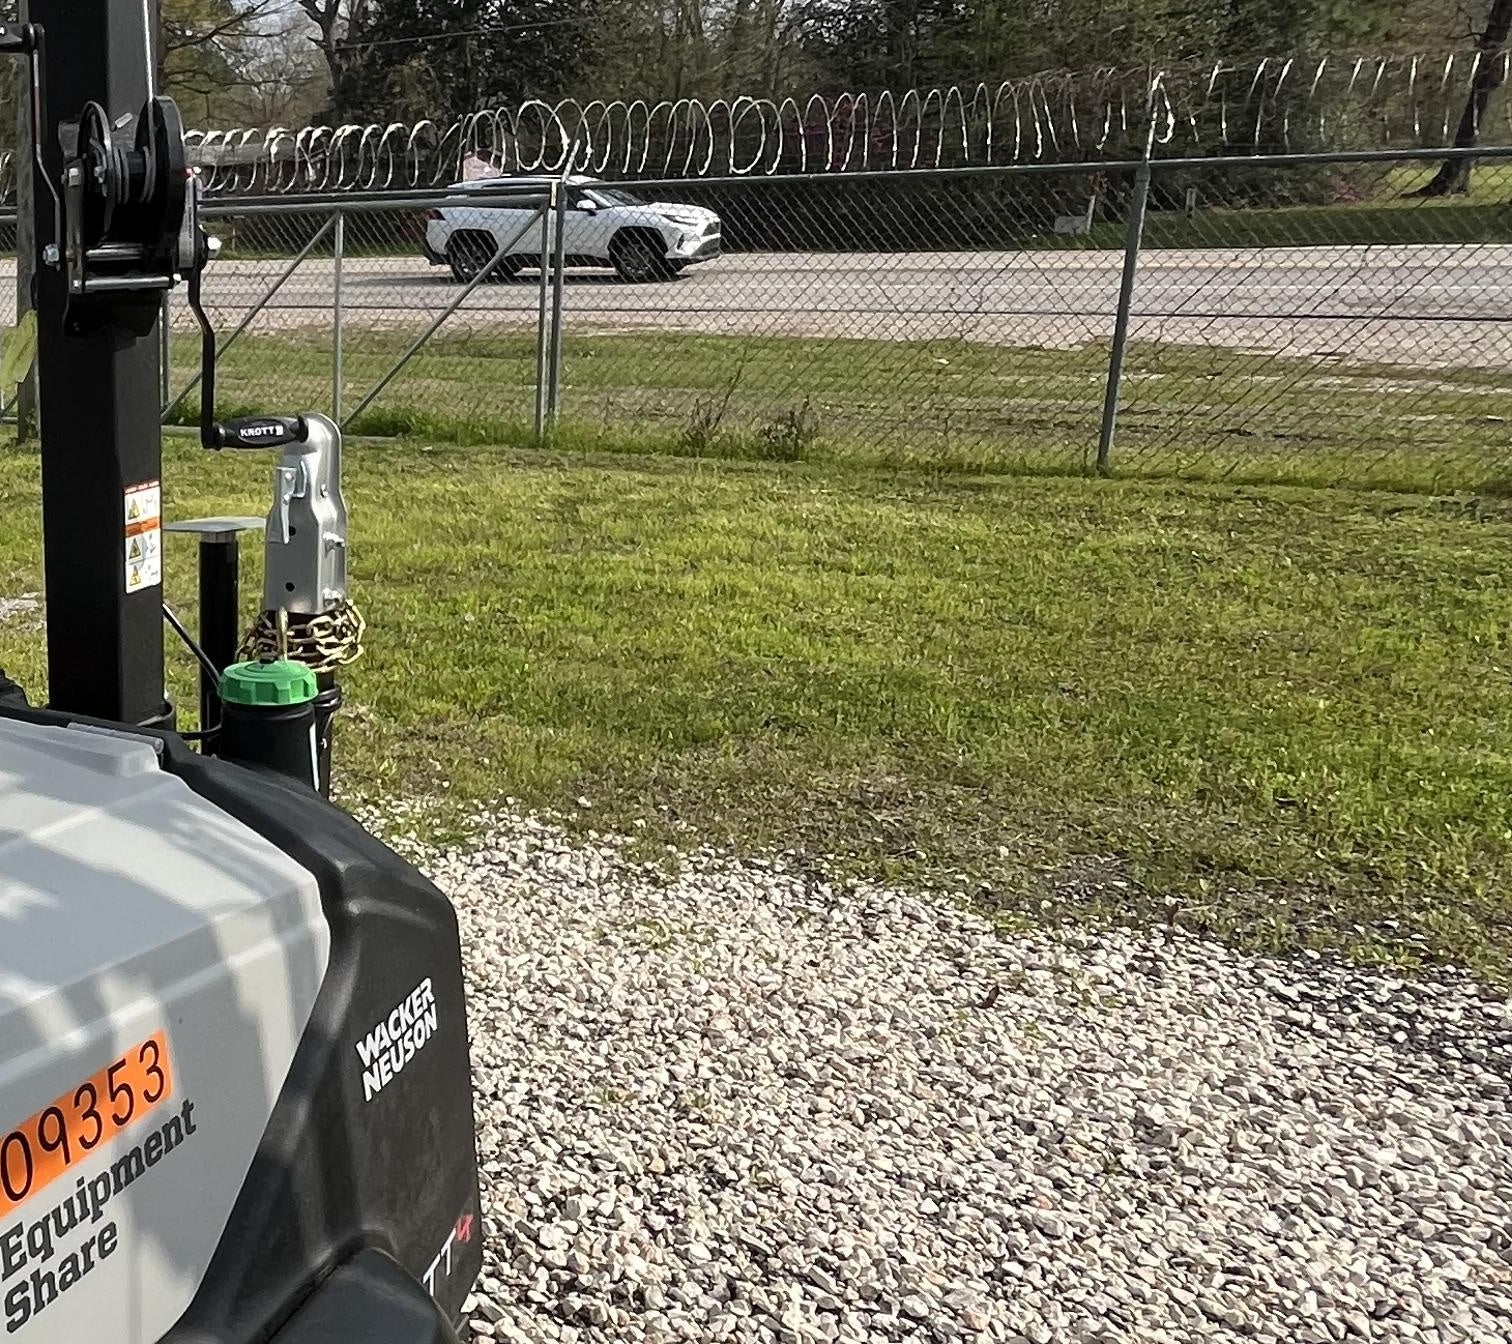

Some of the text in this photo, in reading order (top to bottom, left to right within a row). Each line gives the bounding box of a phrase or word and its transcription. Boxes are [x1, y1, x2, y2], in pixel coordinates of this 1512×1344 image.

[239, 425, 275, 437] KNOTT
[355, 976, 435, 1069] WACKER
[361, 1002, 438, 1102] NEUSON
[3, 1220, 119, 1334] Share
